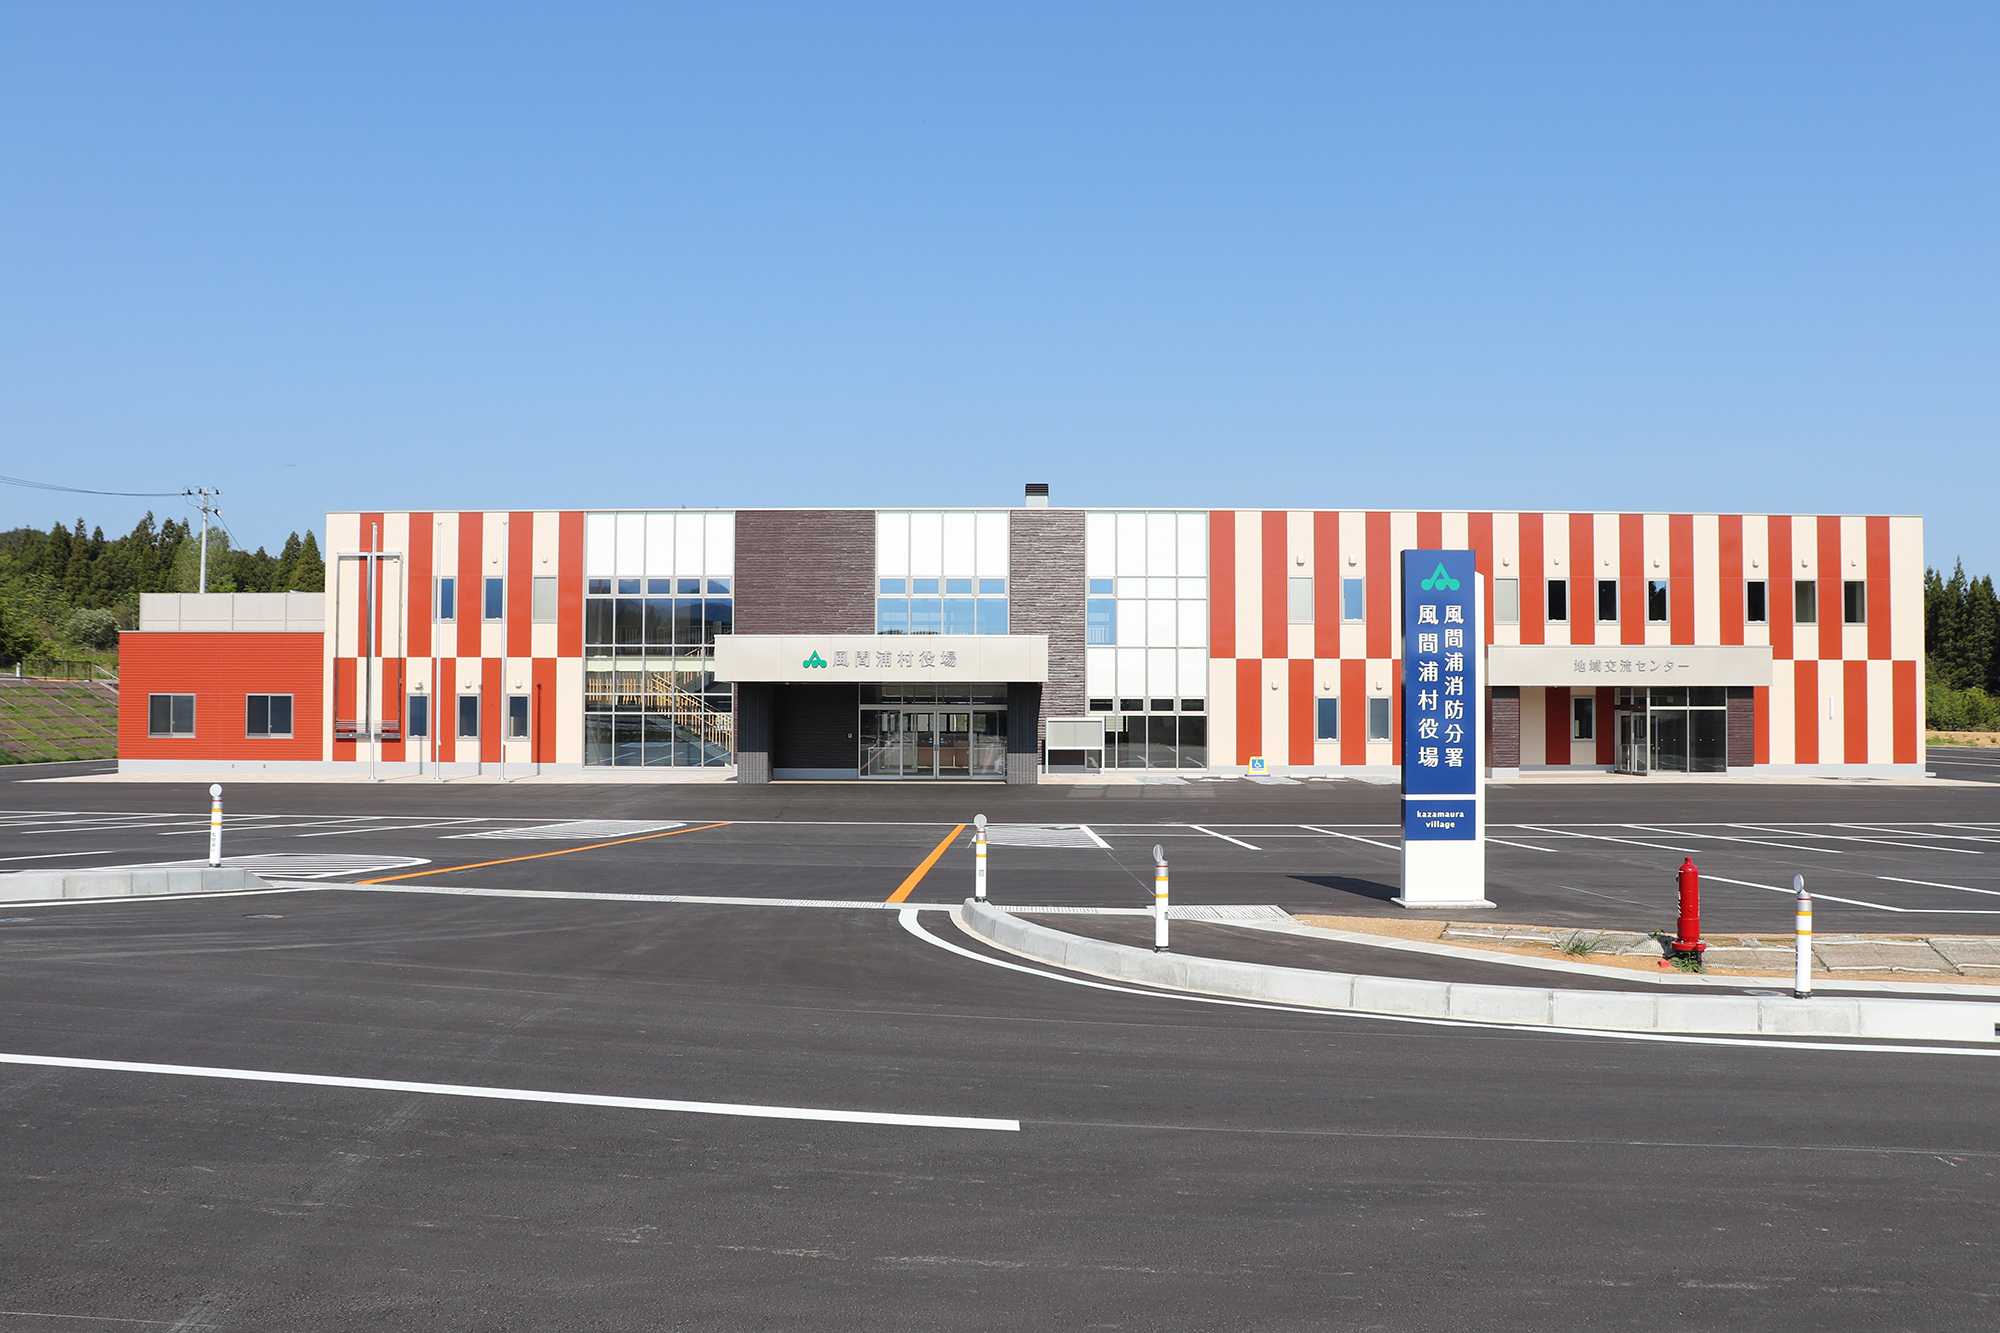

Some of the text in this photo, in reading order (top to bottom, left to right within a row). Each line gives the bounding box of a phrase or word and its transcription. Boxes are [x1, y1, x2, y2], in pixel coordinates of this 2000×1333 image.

[832, 650, 957, 668] 風間浦村役場
[1573, 659, 1690, 673] 地域交流センター
[1417, 604, 1439, 768] 風間浦村役場
[1444, 604, 1464, 768] 風間浦消防分署
[1416, 810, 1465, 818] kazamaura
[1425, 820, 1456, 830] village
